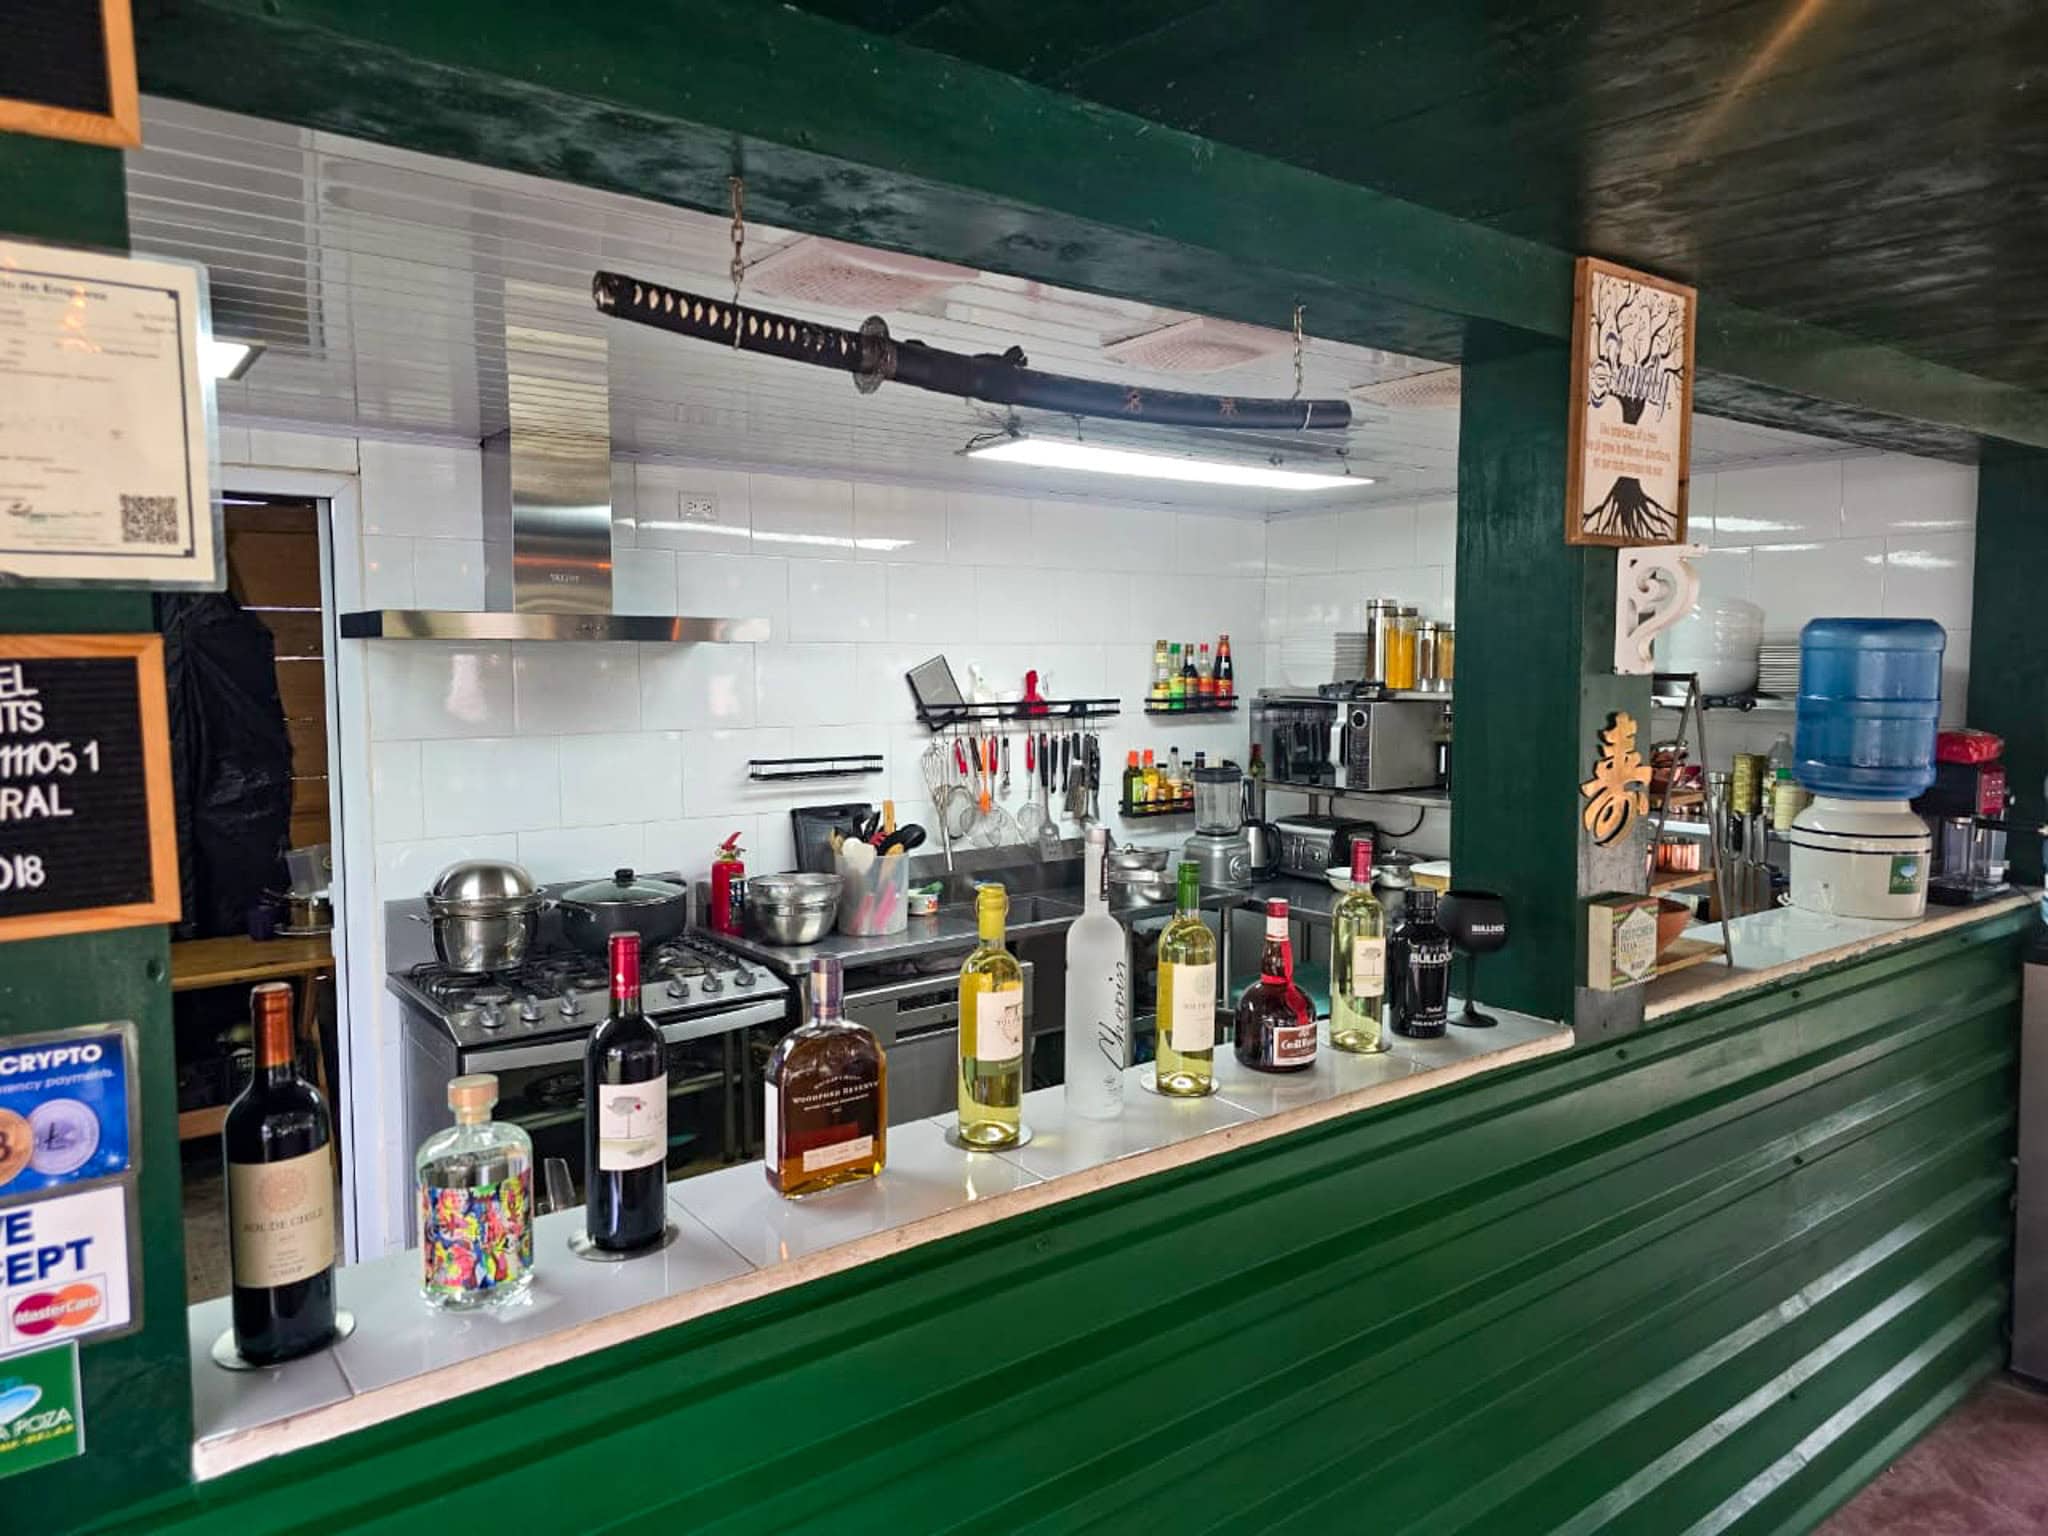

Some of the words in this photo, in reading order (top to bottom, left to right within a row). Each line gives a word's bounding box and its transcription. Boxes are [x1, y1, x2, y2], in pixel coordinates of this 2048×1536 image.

[83, 740, 99, 773] 1
[0, 783, 74, 821] RAL
[0, 1043, 103, 1077] CRYPTO
[0, 1211, 33, 1246] E
[0, 1237, 93, 1287] EPT
[13, 1408, 72, 1437] POZA
